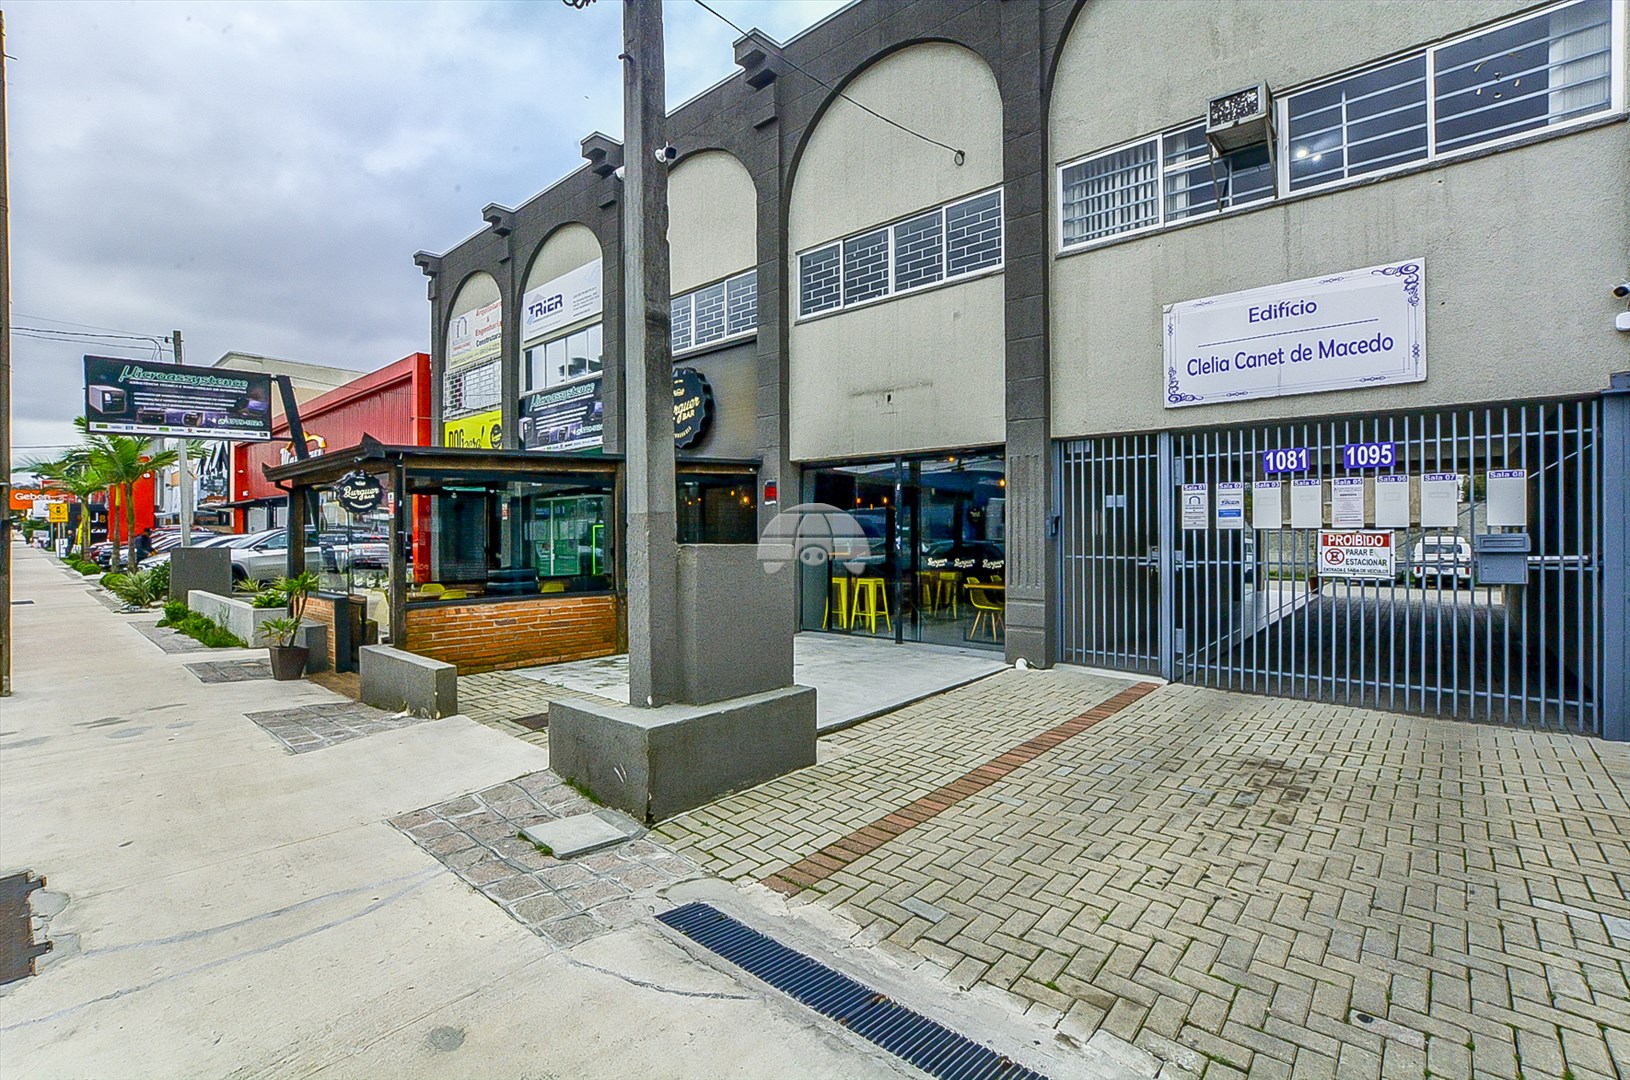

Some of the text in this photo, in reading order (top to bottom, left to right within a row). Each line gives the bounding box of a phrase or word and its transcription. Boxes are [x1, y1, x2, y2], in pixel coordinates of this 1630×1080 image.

[1248, 300, 1318, 323] Edifício
[1187, 332, 1394, 376] Clelia Canet de Macedo
[1265, 448, 1307, 471] 1081
[1346, 444, 1392, 466] 1095
[1378, 475, 1397, 483] Sala
[1425, 473, 1457, 482] Sala 07
[1490, 471, 1510, 479] Sala
[1327, 534, 1384, 547] PROIBIDO
[1345, 548, 1368, 556] PARAR
[1345, 558, 1388, 566] ESTACIONAR
